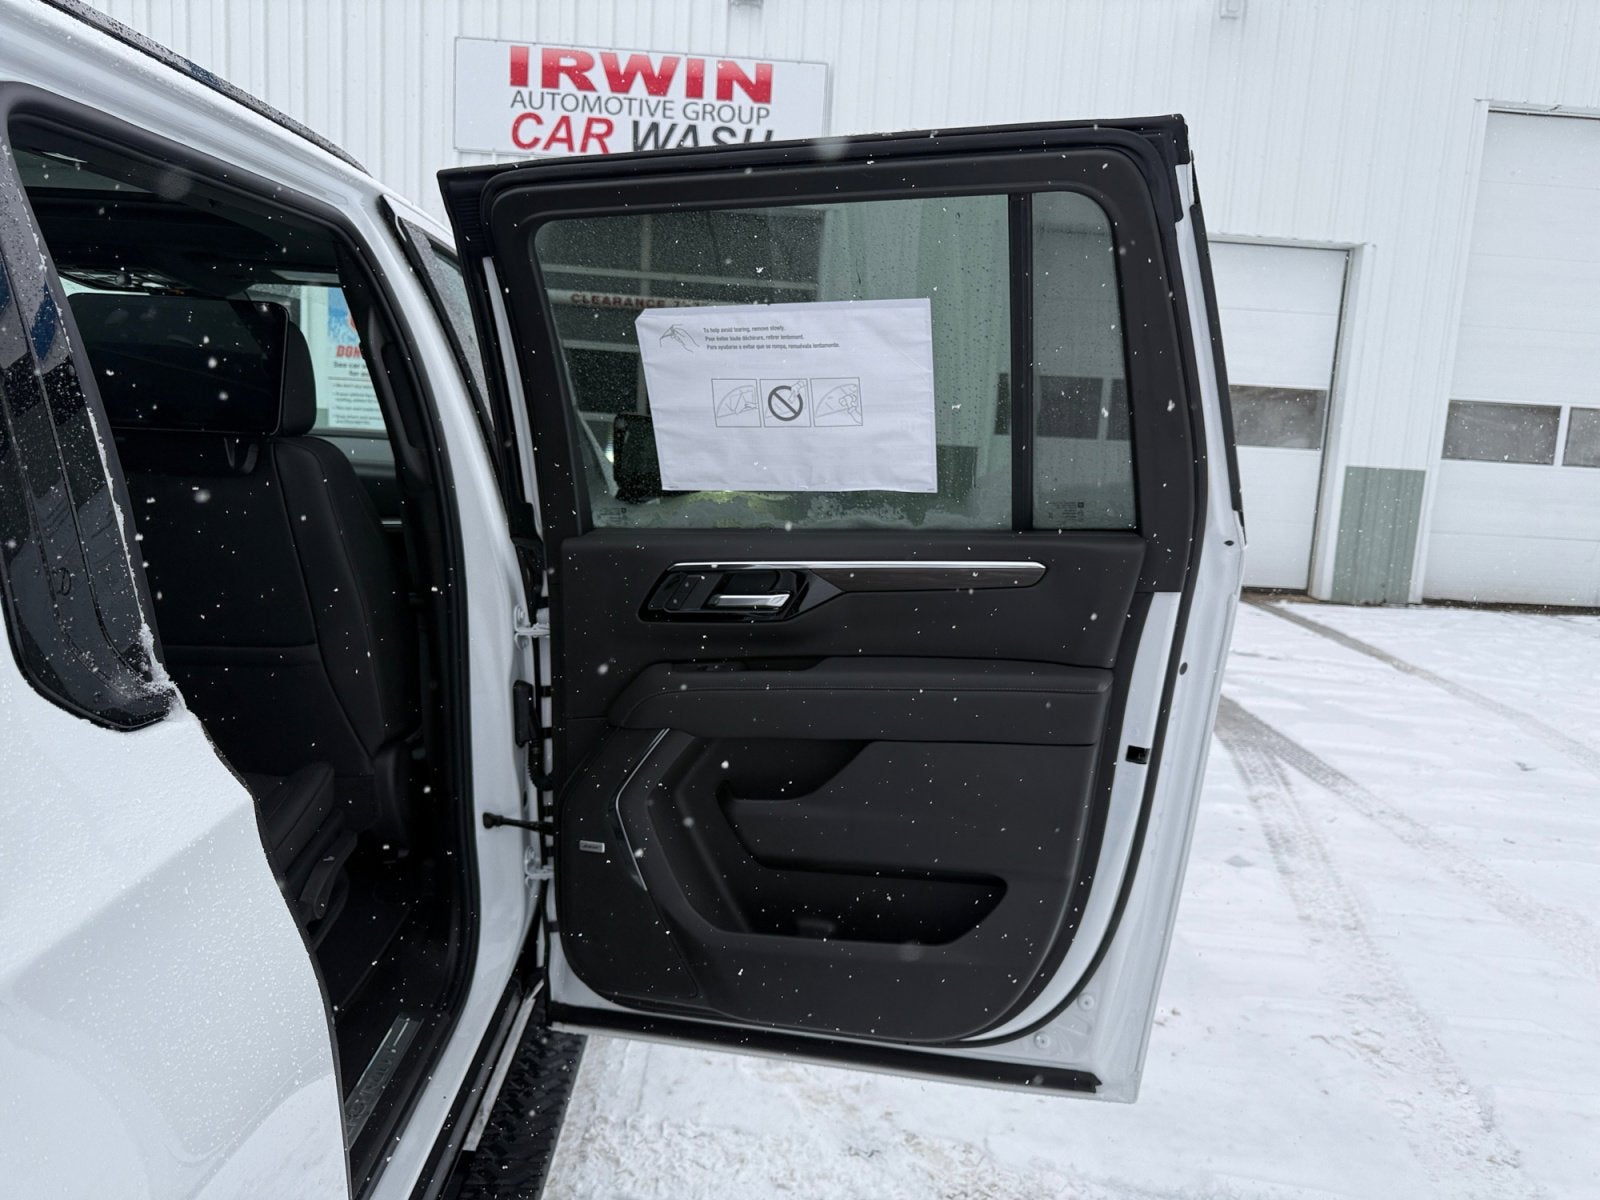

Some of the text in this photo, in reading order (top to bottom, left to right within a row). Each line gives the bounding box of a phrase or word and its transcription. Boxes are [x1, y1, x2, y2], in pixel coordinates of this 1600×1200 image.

[510, 45, 773, 105] IRWIN
[510, 89, 770, 125] AUTOMOTIVE GROUP
[511, 112, 614, 154] CAR
[571, 293, 665, 308] CLEARANCE
[733, 326, 750, 334] tearing,
